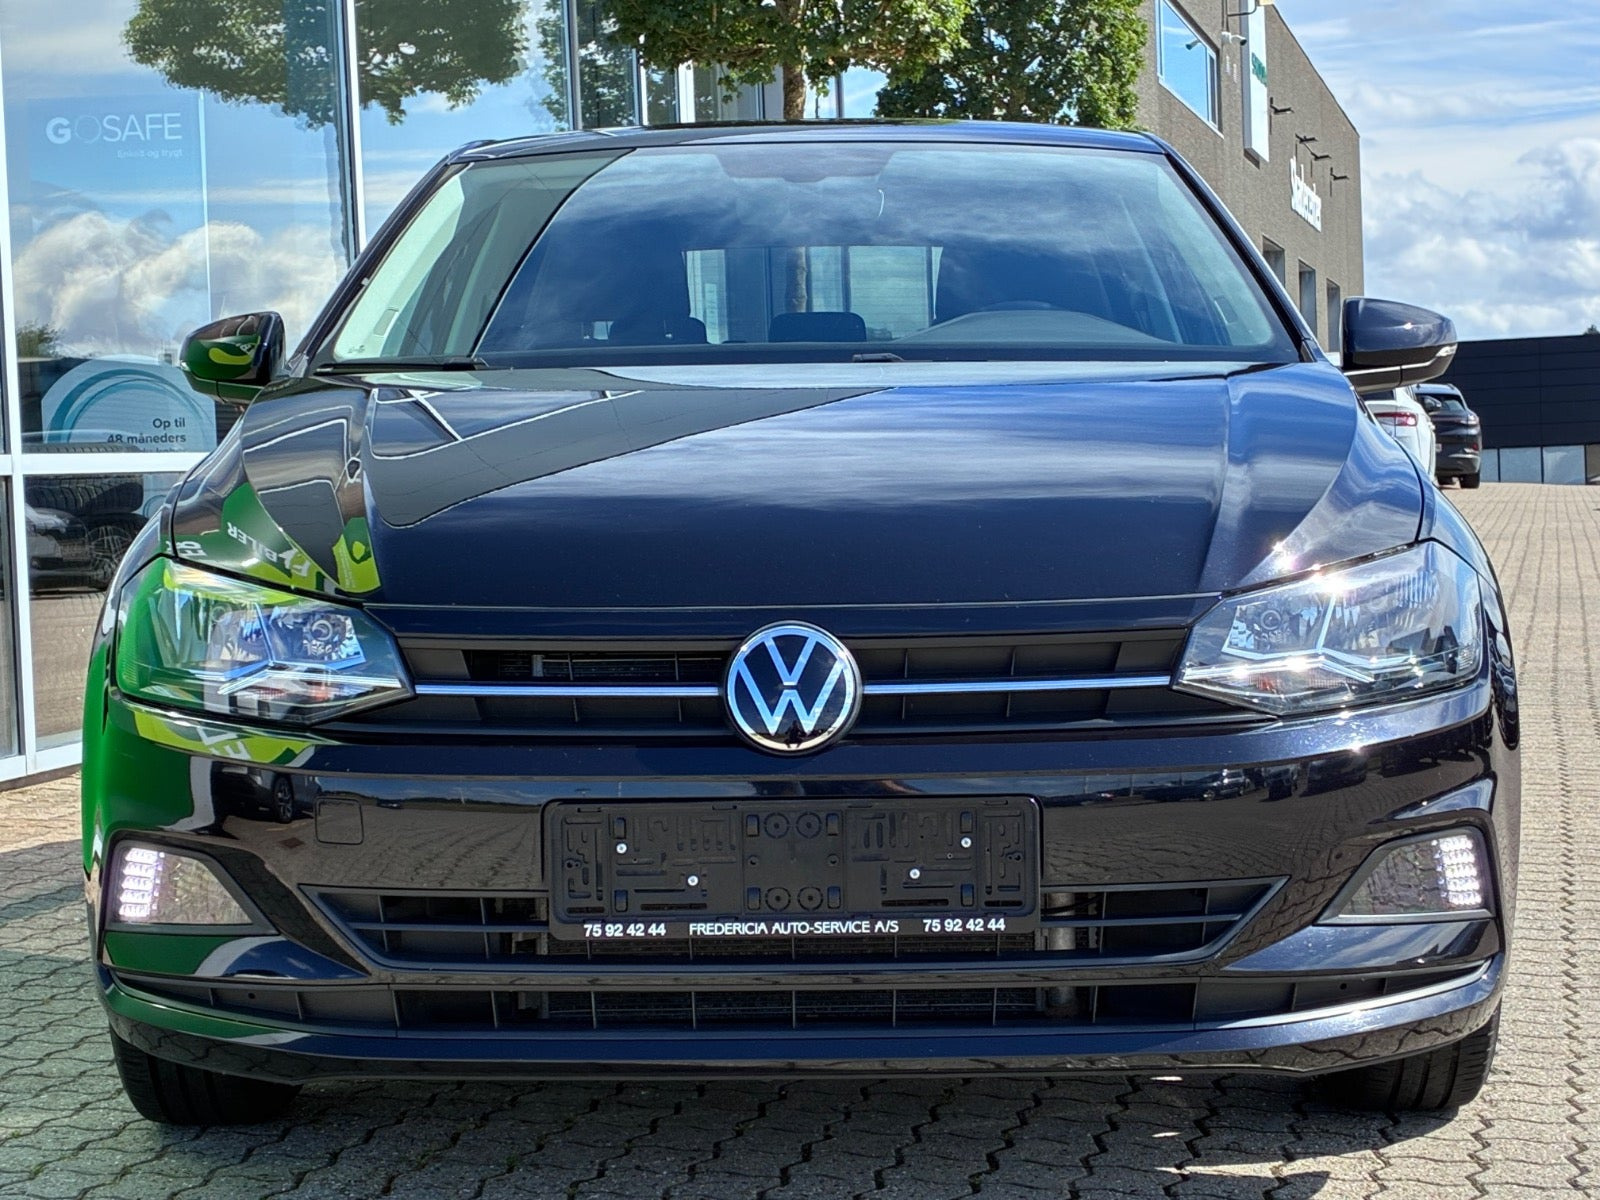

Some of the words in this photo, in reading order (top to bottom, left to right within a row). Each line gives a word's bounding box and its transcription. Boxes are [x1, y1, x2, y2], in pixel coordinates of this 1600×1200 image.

[45, 112, 183, 145] GOSAFE
[153, 418, 171, 430] Op
[174, 417, 186, 428] til
[107, 434, 123, 443] 48
[127, 432, 186, 444] måneders
[731, 629, 852, 746] VW
[584, 924, 602, 937] 75
[605, 924, 624, 937] 92
[626, 923, 645, 936] 42
[647, 923, 666, 936] 44
[689, 922, 768, 936] FREDERICIA
[771, 920, 870, 935] AUTO-SERVICE
[874, 920, 899, 933] A/S
[923, 919, 941, 933] 75
[944, 919, 962, 932] 92
[966, 918, 984, 932] 42
[987, 918, 1006, 932] 44
